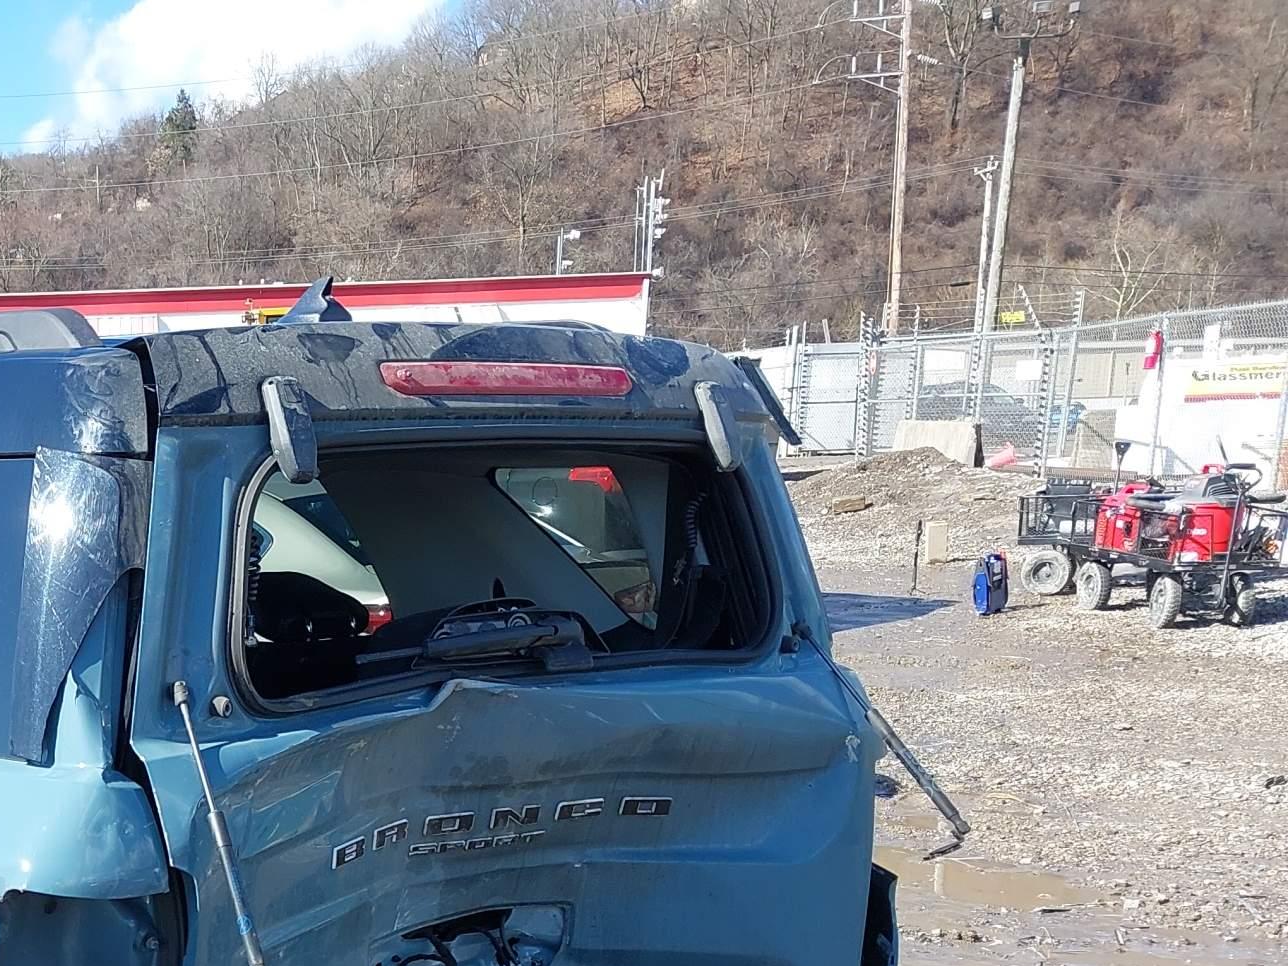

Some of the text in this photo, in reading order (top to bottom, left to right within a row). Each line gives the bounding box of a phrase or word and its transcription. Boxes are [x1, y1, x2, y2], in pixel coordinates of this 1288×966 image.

[1191, 369, 1284, 382] Glassmer
[331, 796, 673, 870] BRONCO
[409, 830, 547, 857] SPORT
